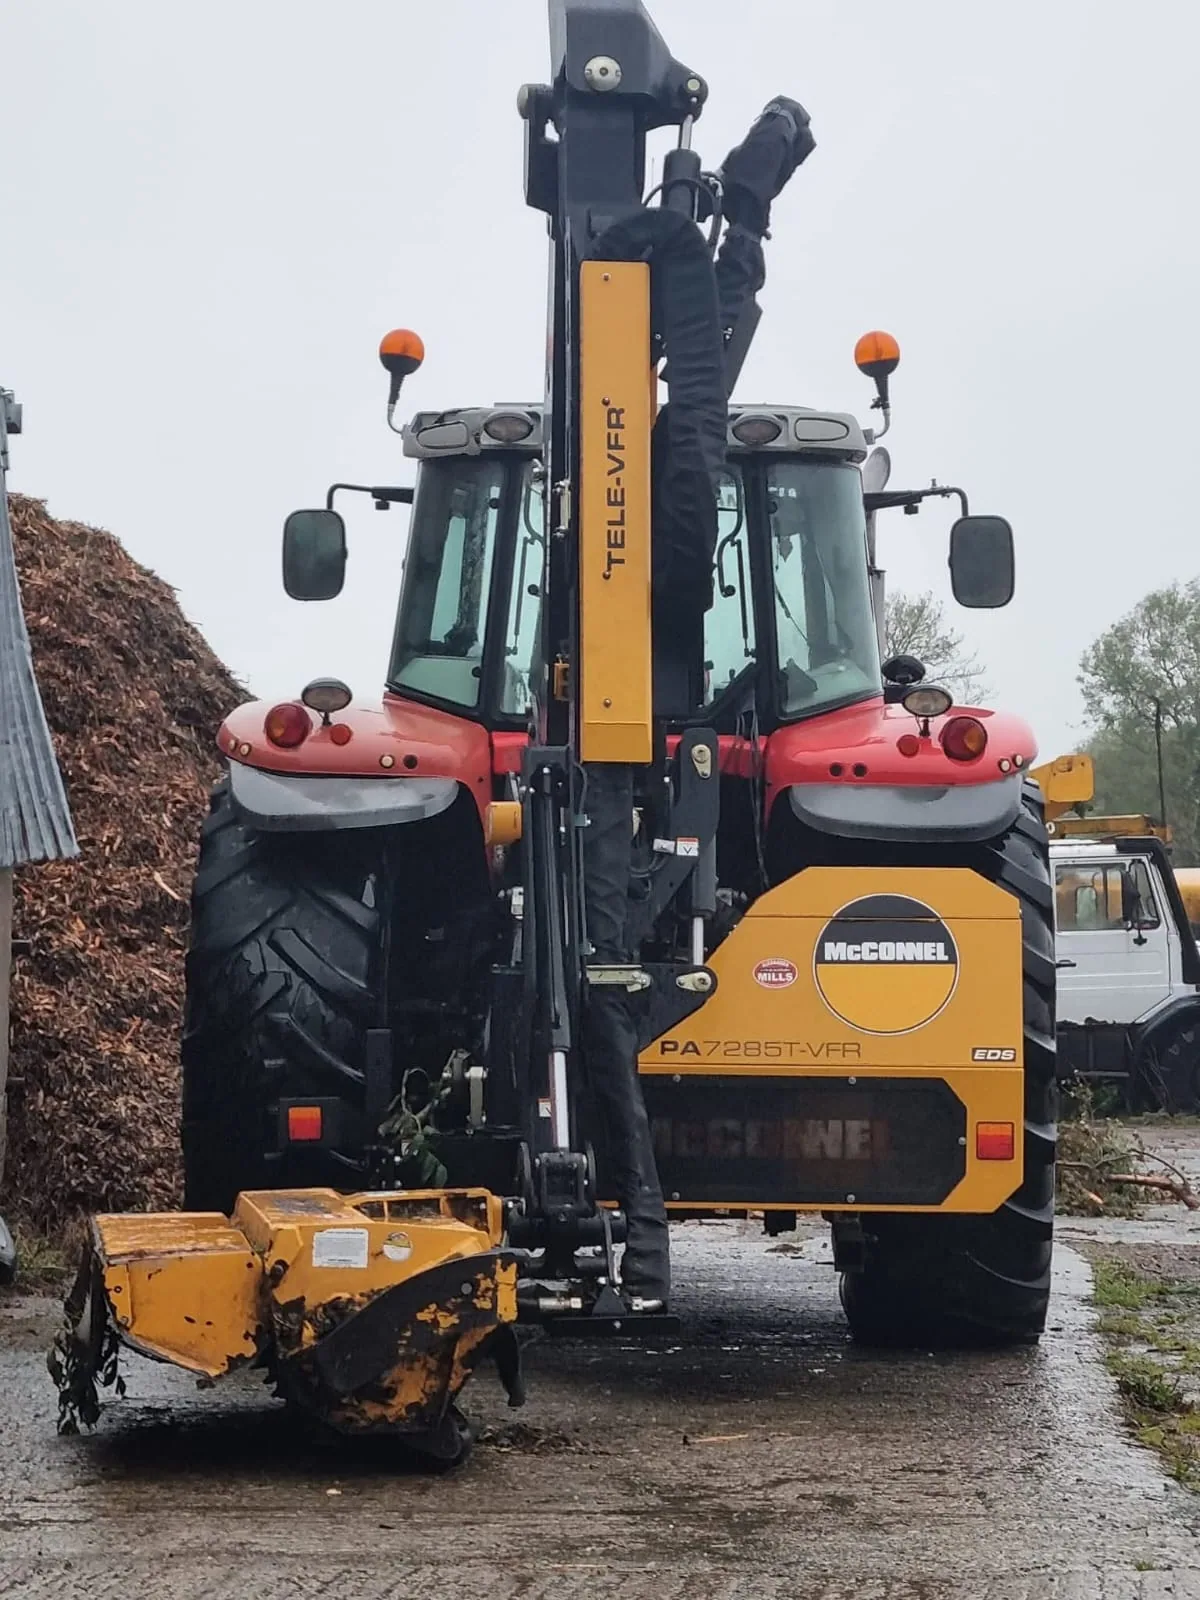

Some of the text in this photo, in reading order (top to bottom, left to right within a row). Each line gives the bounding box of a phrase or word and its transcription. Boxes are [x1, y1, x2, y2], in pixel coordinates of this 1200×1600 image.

[606, 407, 626, 571] TELE-VFR
[824, 941, 949, 961] McCONNEL
[757, 971, 794, 982] MILLS
[973, 1048, 1015, 1060] EDS
